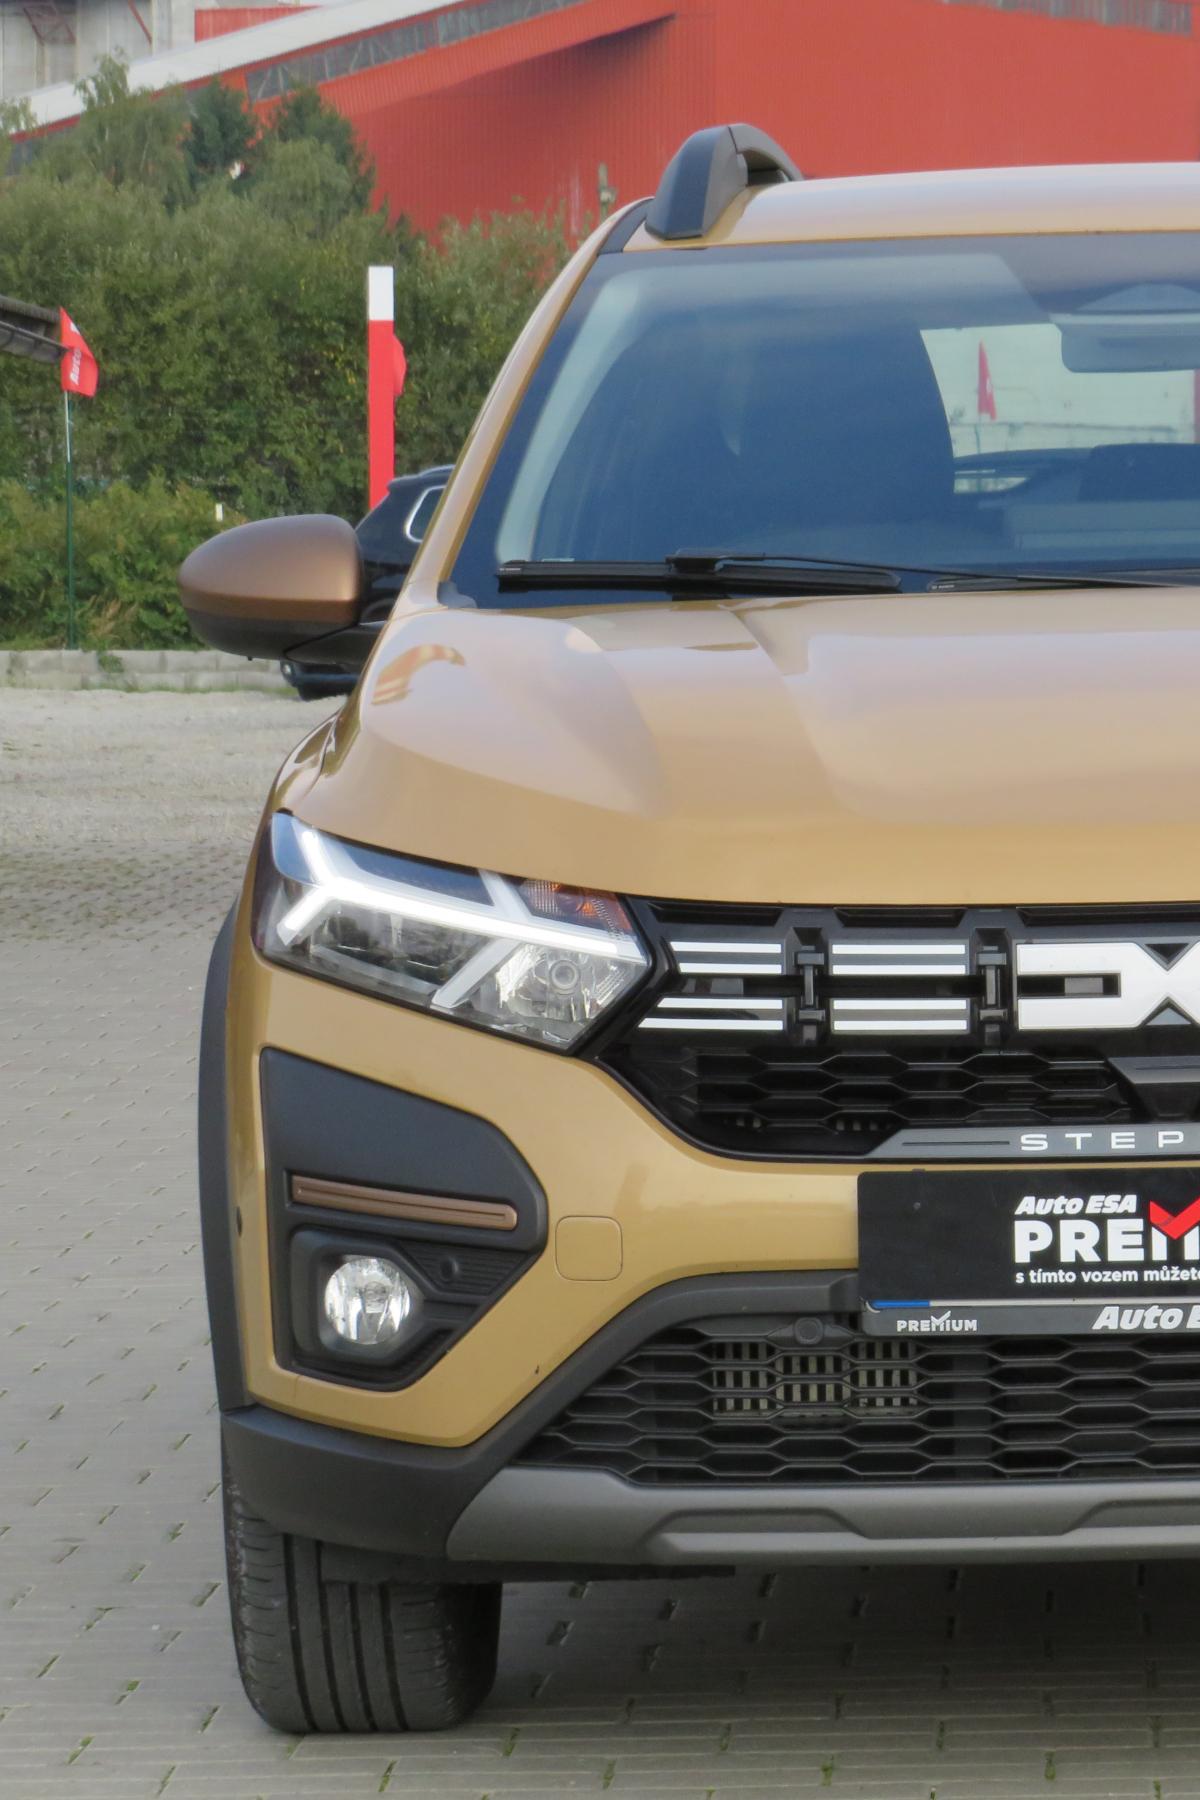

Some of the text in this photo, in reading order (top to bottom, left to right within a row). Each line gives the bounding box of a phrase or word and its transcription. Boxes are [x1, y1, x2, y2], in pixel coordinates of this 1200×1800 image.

[1014, 1194, 1138, 1216] Auto ESA
[1015, 1271, 1025, 1284] s
[1029, 1267, 1077, 1284] tímto
[1081, 1269, 1139, 1283] vozem
[896, 1311, 977, 1332] PREMIUM
[1092, 1305, 1183, 1330] Auto
